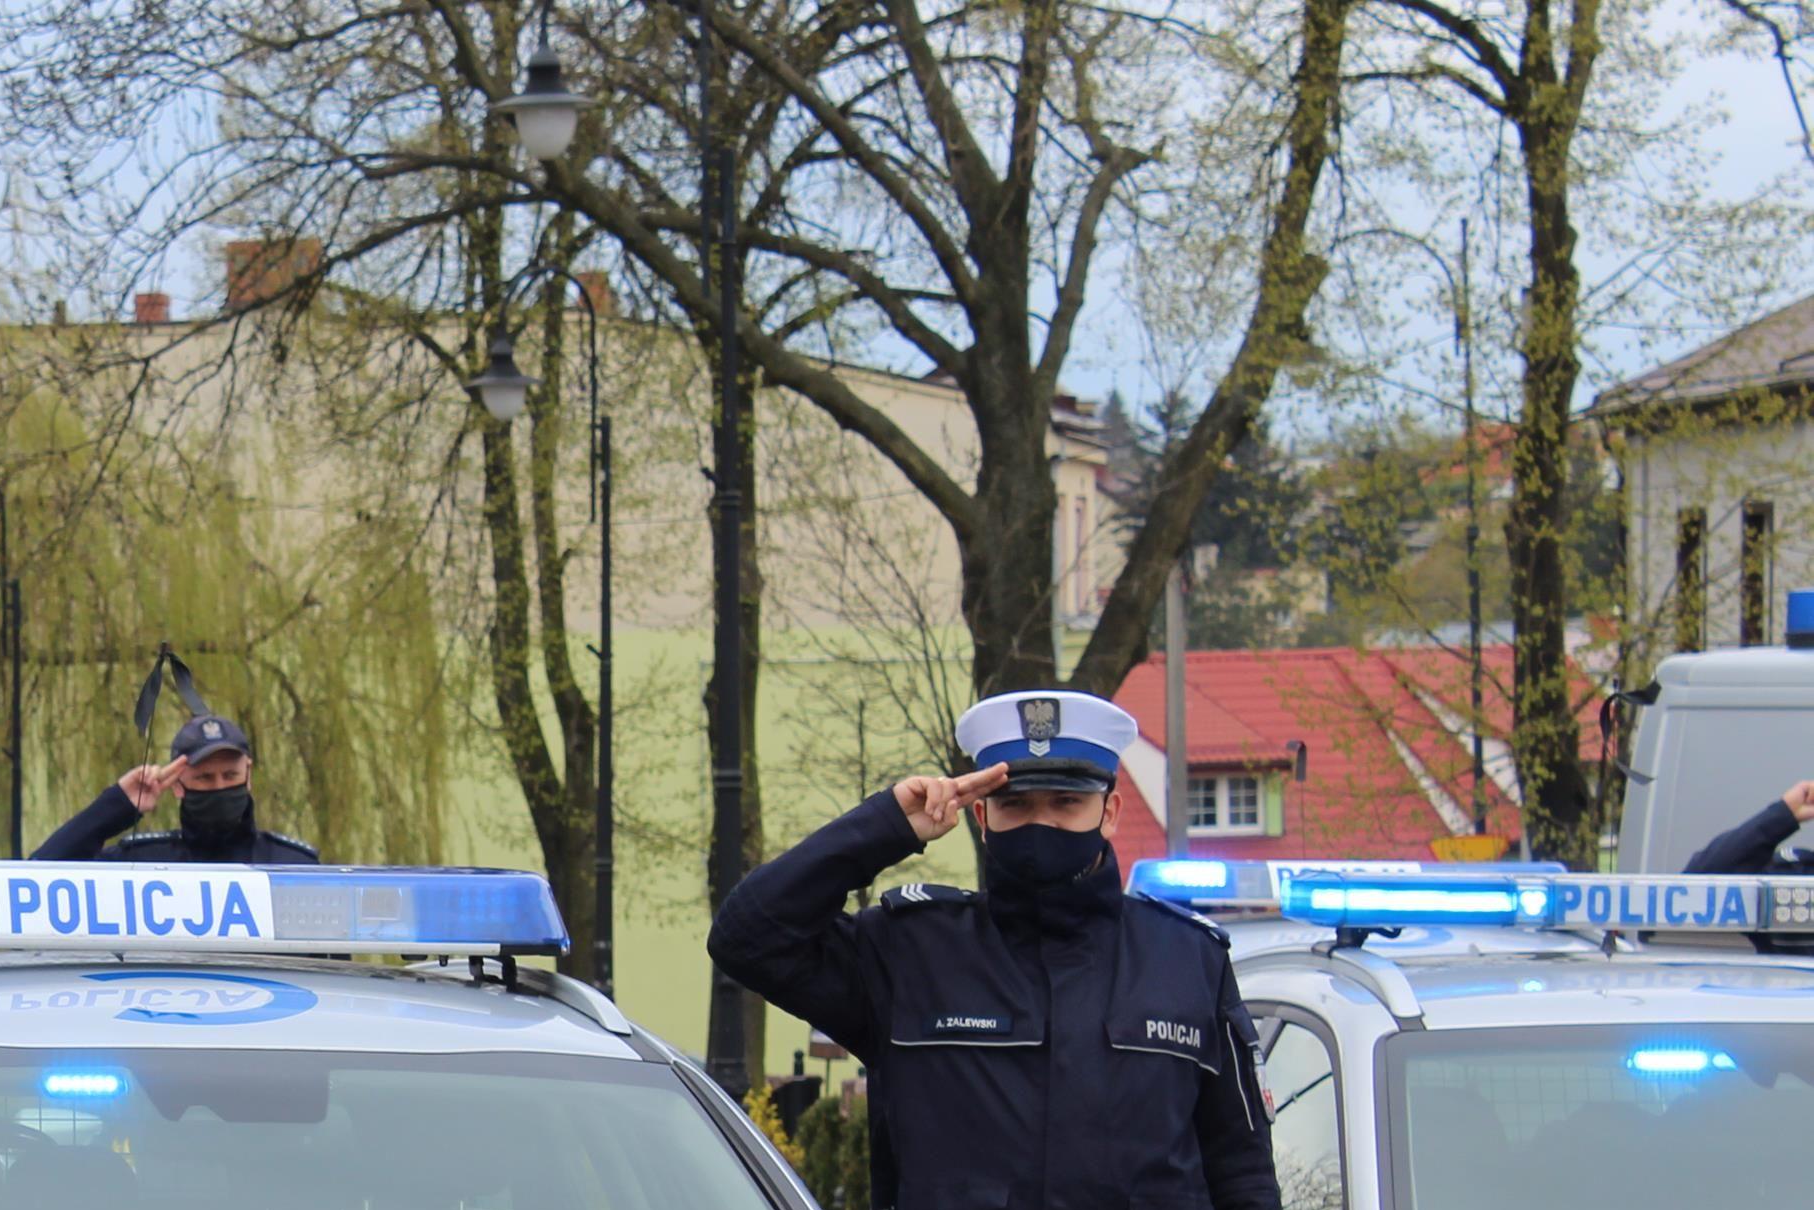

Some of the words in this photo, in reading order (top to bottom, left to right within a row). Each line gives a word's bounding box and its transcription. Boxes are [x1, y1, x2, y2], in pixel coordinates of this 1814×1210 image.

[8, 878, 260, 937] POLICJA
[1556, 884, 1748, 927] POLICJA
[936, 1018, 945, 1028] A.
[946, 1017, 997, 1028] ZALEWSKI
[1146, 1020, 1200, 1048] POLICJA
